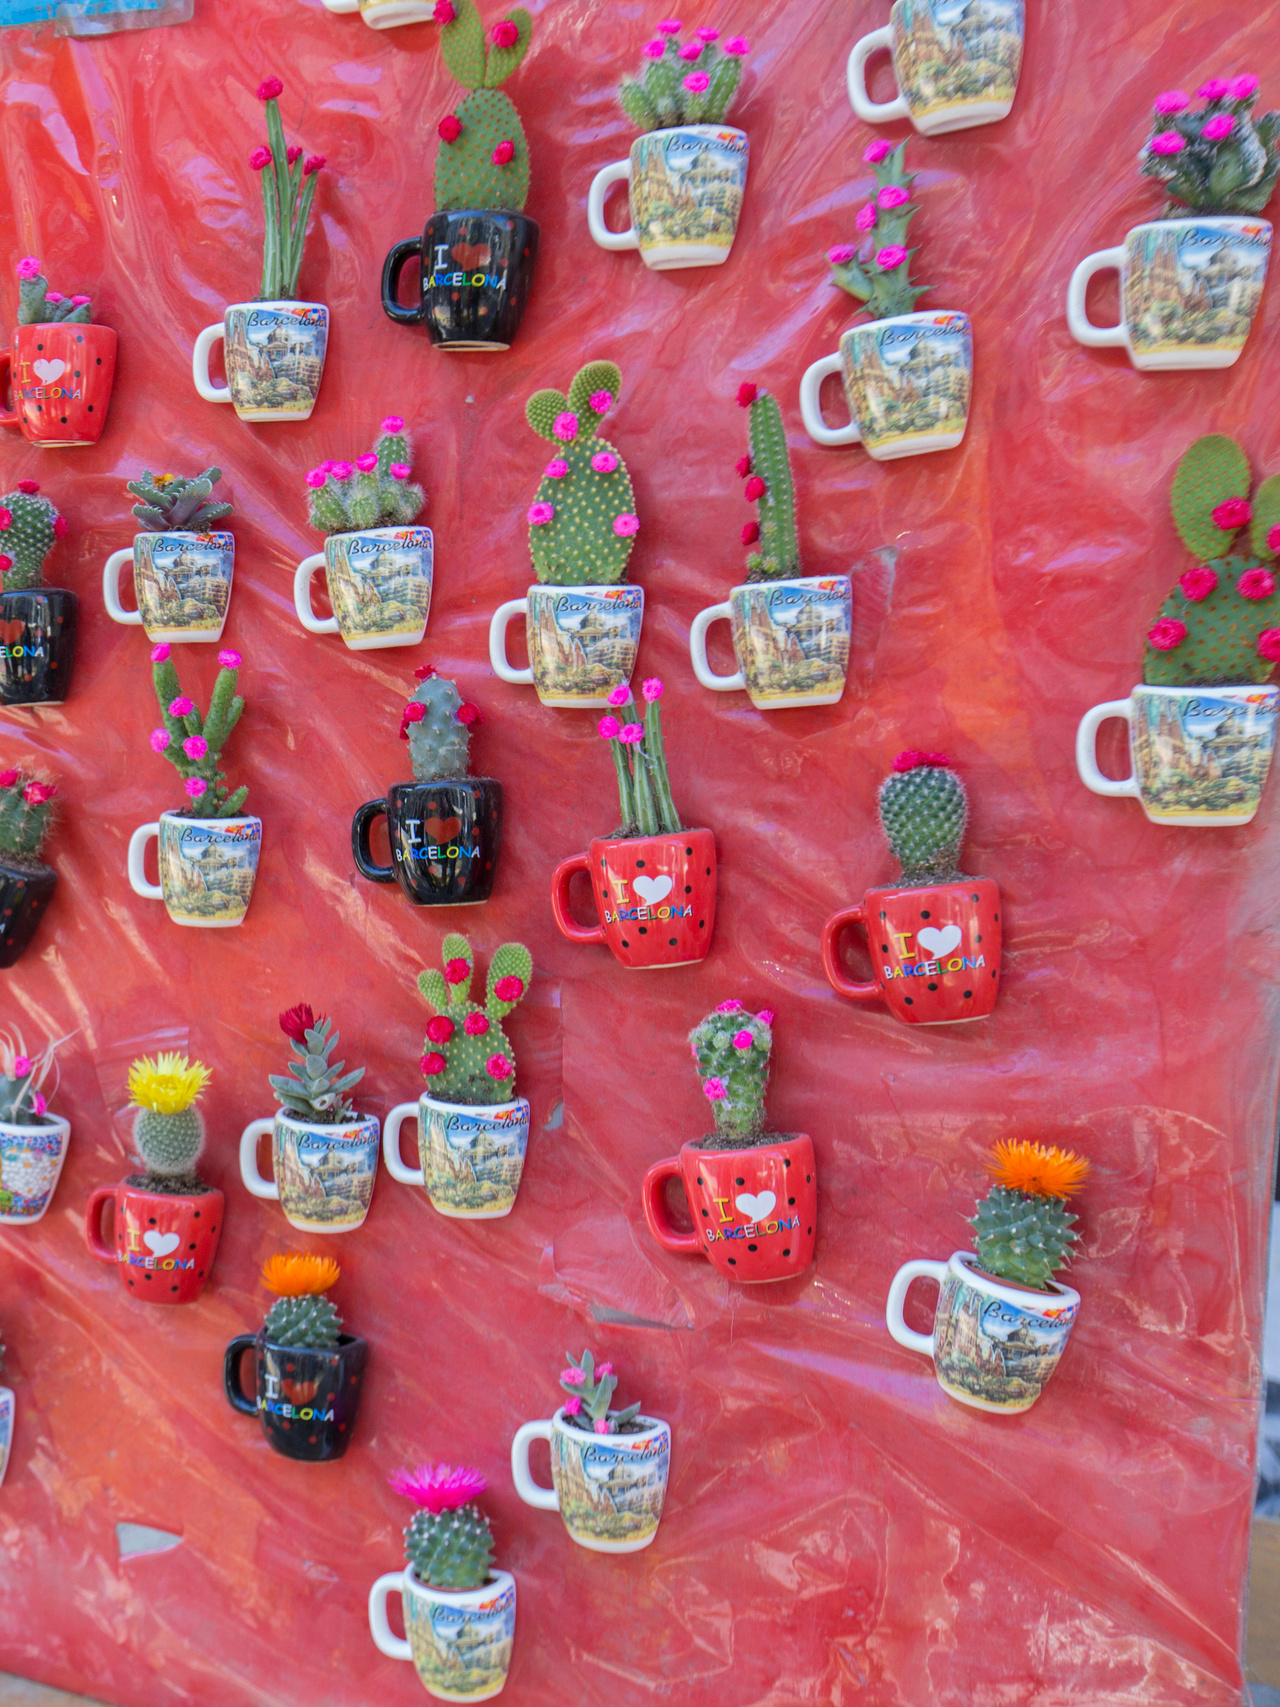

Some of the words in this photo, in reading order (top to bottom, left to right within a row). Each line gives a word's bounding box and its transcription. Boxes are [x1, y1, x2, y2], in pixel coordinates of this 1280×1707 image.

[434, 244, 449, 270] I
[423, 272, 507, 291] BARCELONA
[246, 312, 325, 327] Barcelona
[19, 362, 31, 383] I
[152, 537, 233, 552] Barcelona
[347, 537, 429, 555] Barcelona
[555, 595, 640, 613] Barcelona
[180, 825, 260, 843] Barcelona
[405, 819, 422, 843] I
[396, 845, 480, 861] BARCELONA
[613, 880, 629, 904] I
[604, 905, 691, 924] BARCELONA
[894, 933, 916, 959] I
[883, 955, 986, 979] BARCELONA
[446, 1116, 529, 1132] Barcelona
[298, 1134, 377, 1150] Barcelona
[713, 1198, 734, 1224] I
[706, 1215, 800, 1242] BARCELONA
[127, 1227, 140, 1251] I
[264, 1373, 279, 1399] I
[256, 1395, 334, 1422] BARCELONA
[583, 1446, 667, 1462] Barcelona
[432, 1603, 513, 1622] Barcelona
